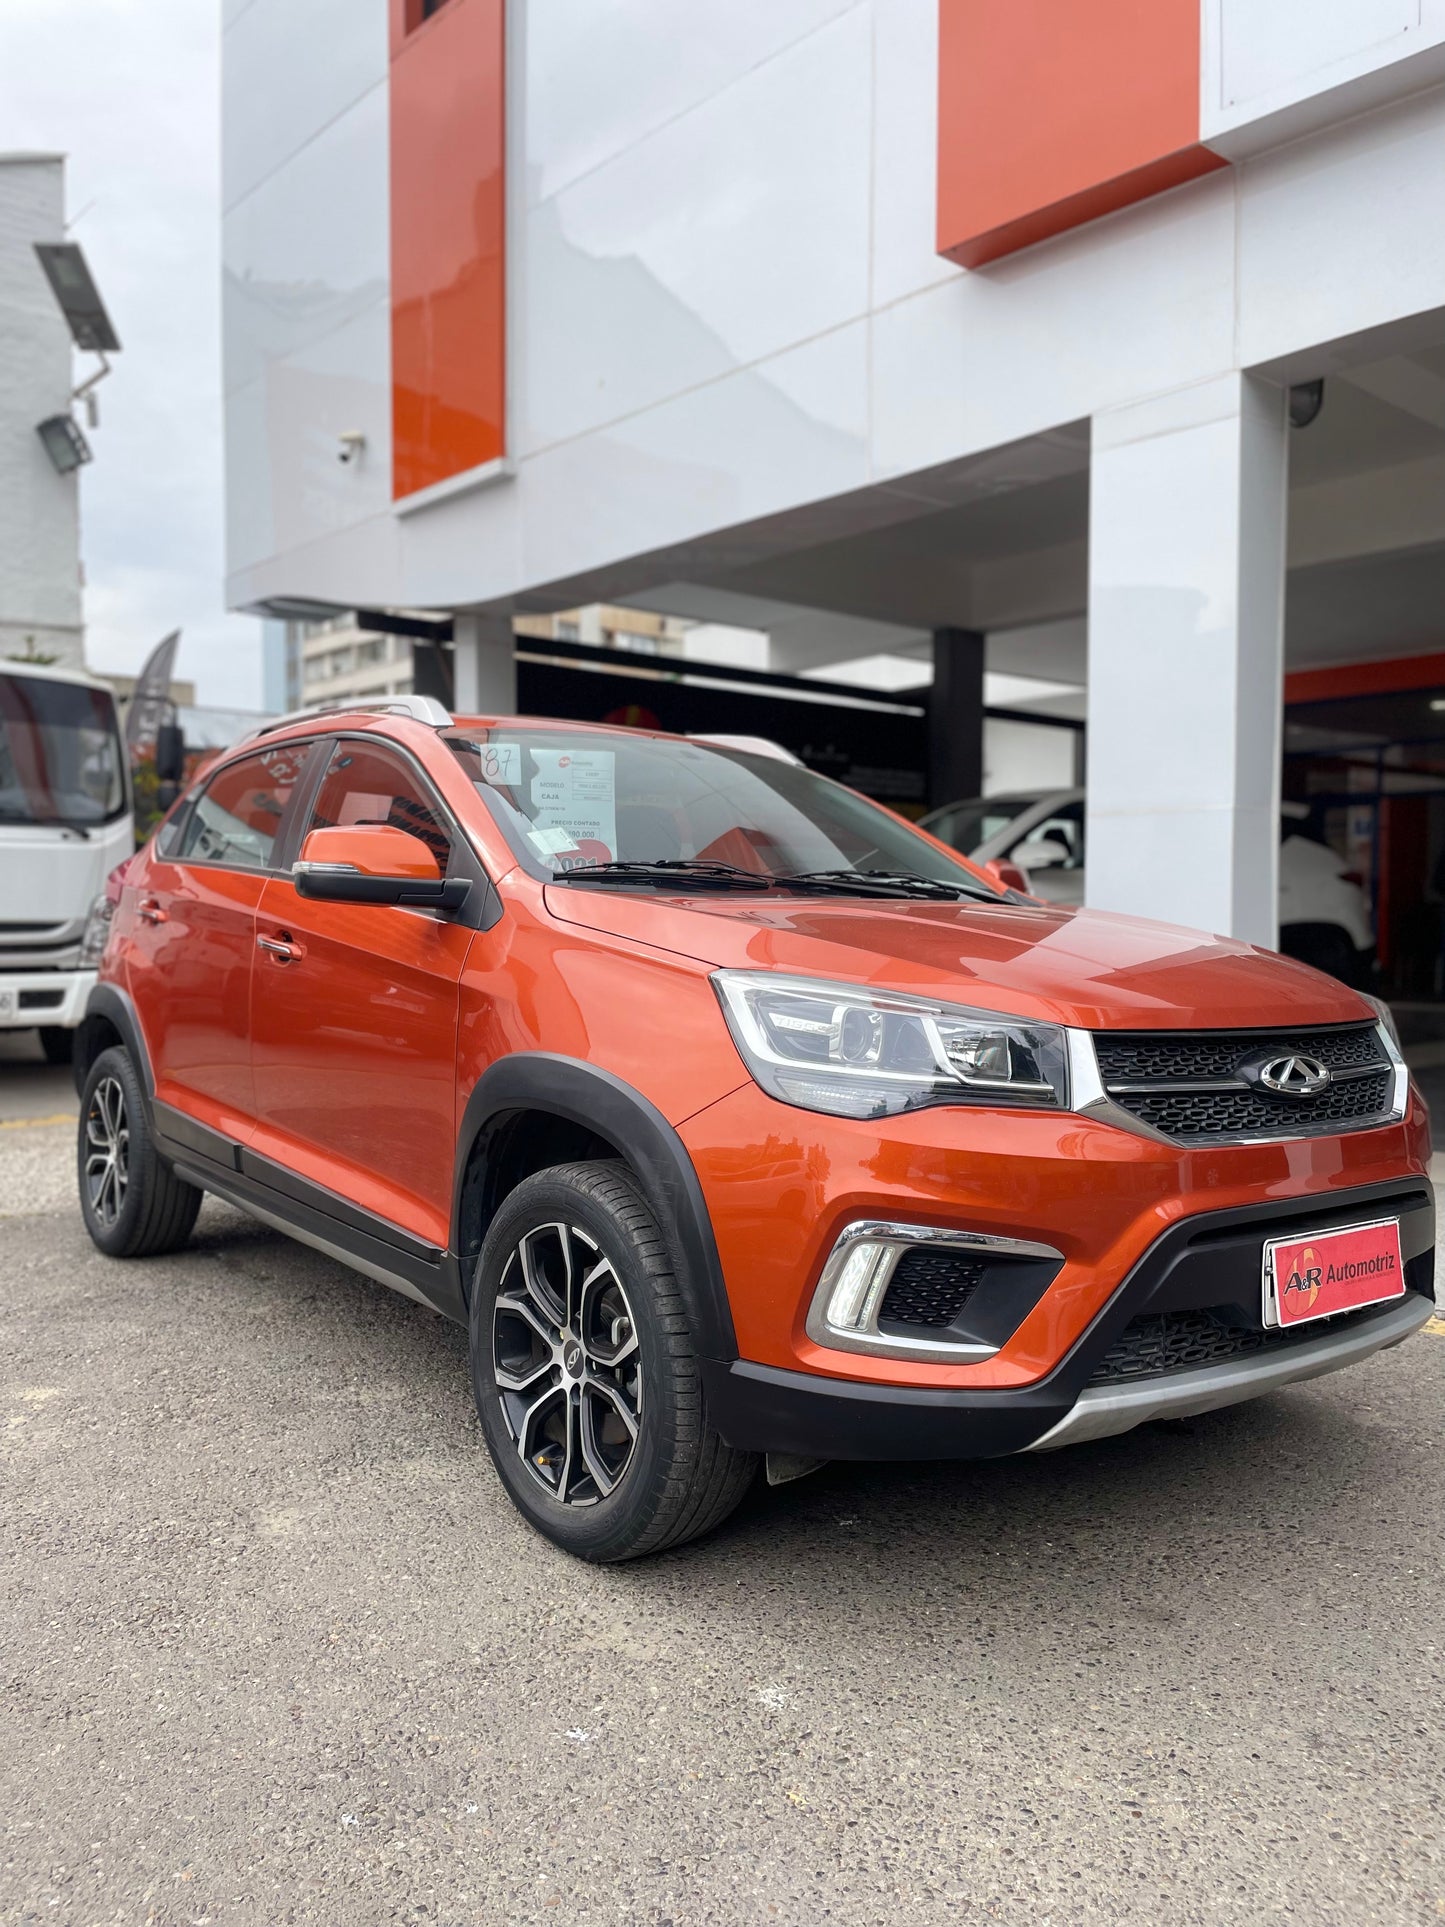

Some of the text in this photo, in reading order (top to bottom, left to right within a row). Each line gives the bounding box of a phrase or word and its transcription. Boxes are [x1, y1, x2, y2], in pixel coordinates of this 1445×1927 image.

[486, 748, 512, 776] 87
[1284, 1266, 1323, 1296] A&R
[1326, 1252, 1395, 1284] Automotriz
